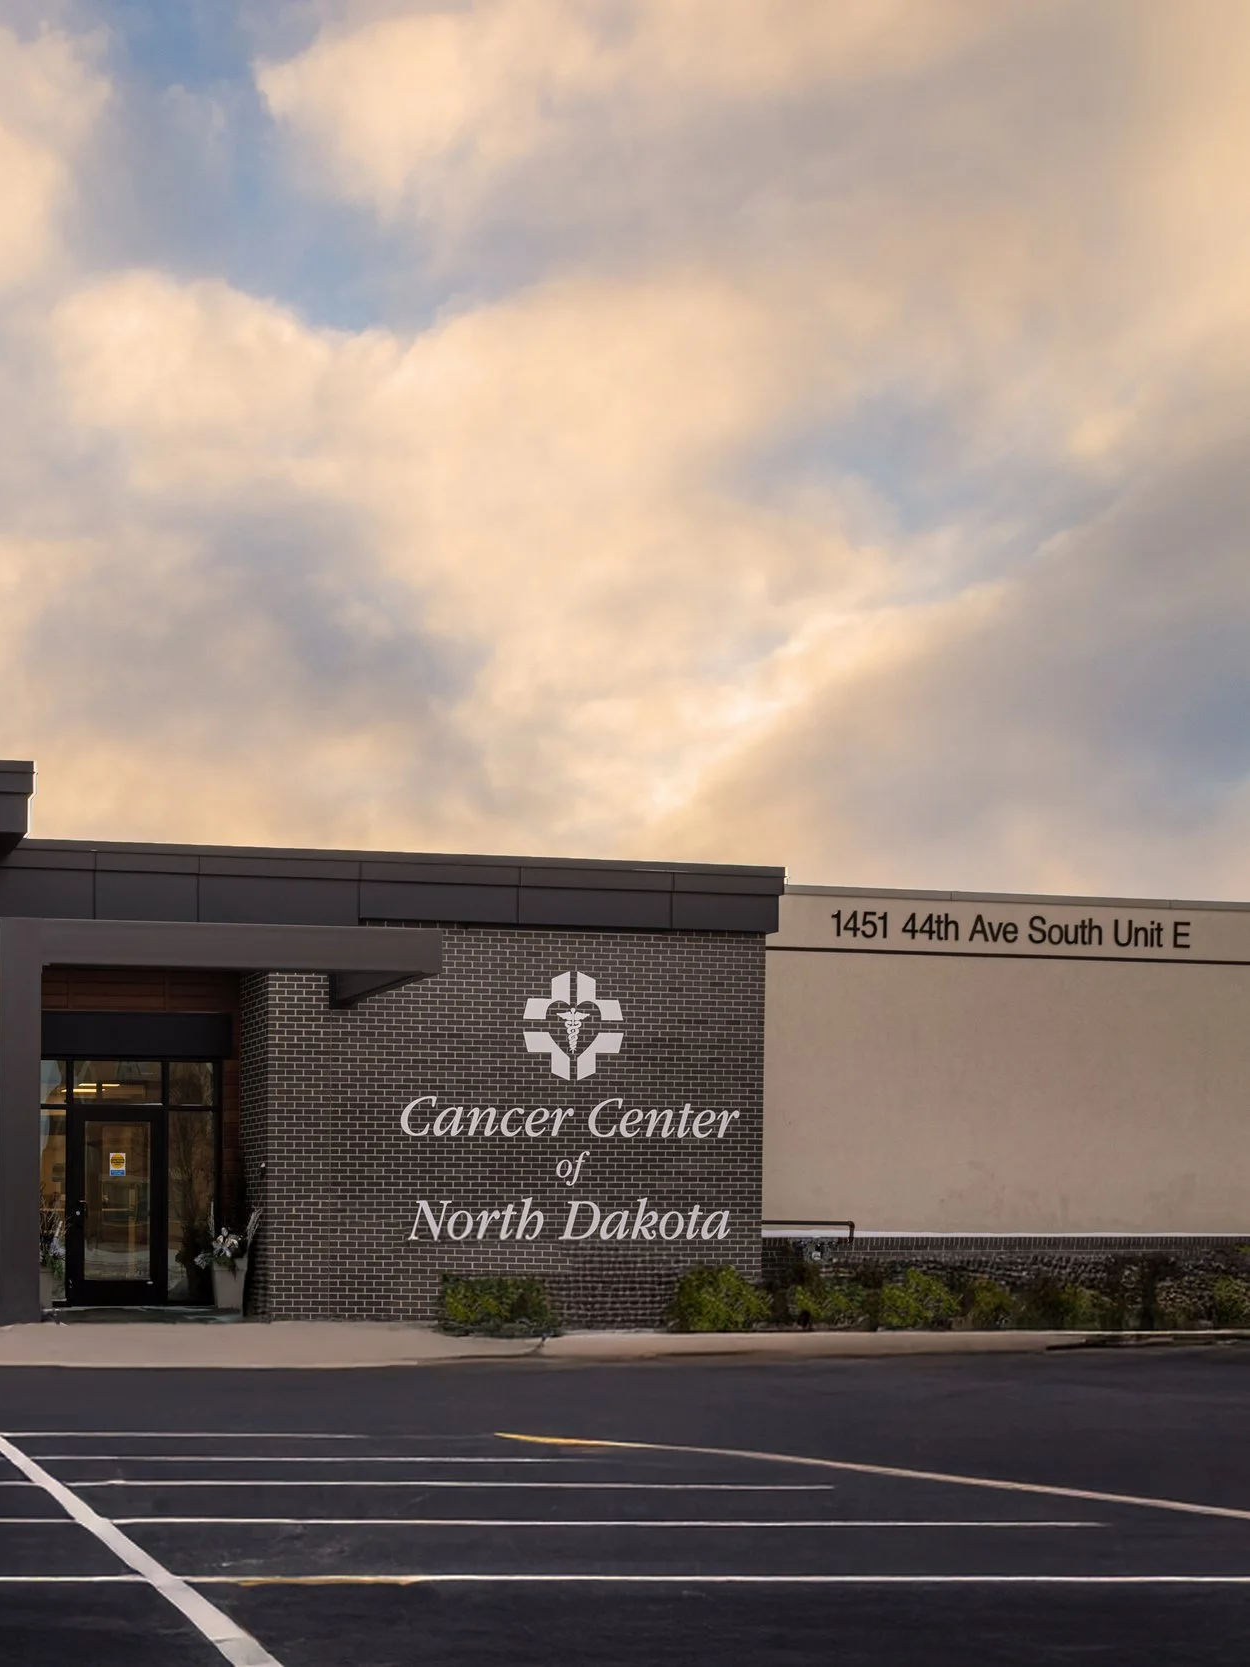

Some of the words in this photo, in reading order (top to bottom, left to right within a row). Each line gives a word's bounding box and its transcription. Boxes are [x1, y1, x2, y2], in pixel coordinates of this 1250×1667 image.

[831, 909, 889, 939] 1451
[901, 912, 959, 942] 44th
[968, 914, 1019, 943] Ave
[1028, 915, 1103, 946] South
[1114, 919, 1164, 948] Unit
[1174, 921, 1191, 948] E
[400, 1095, 575, 1138] Cancer
[587, 1097, 740, 1139] Center
[555, 1151, 590, 1186] of
[408, 1197, 545, 1241] North
[558, 1197, 731, 1241] Dakota
